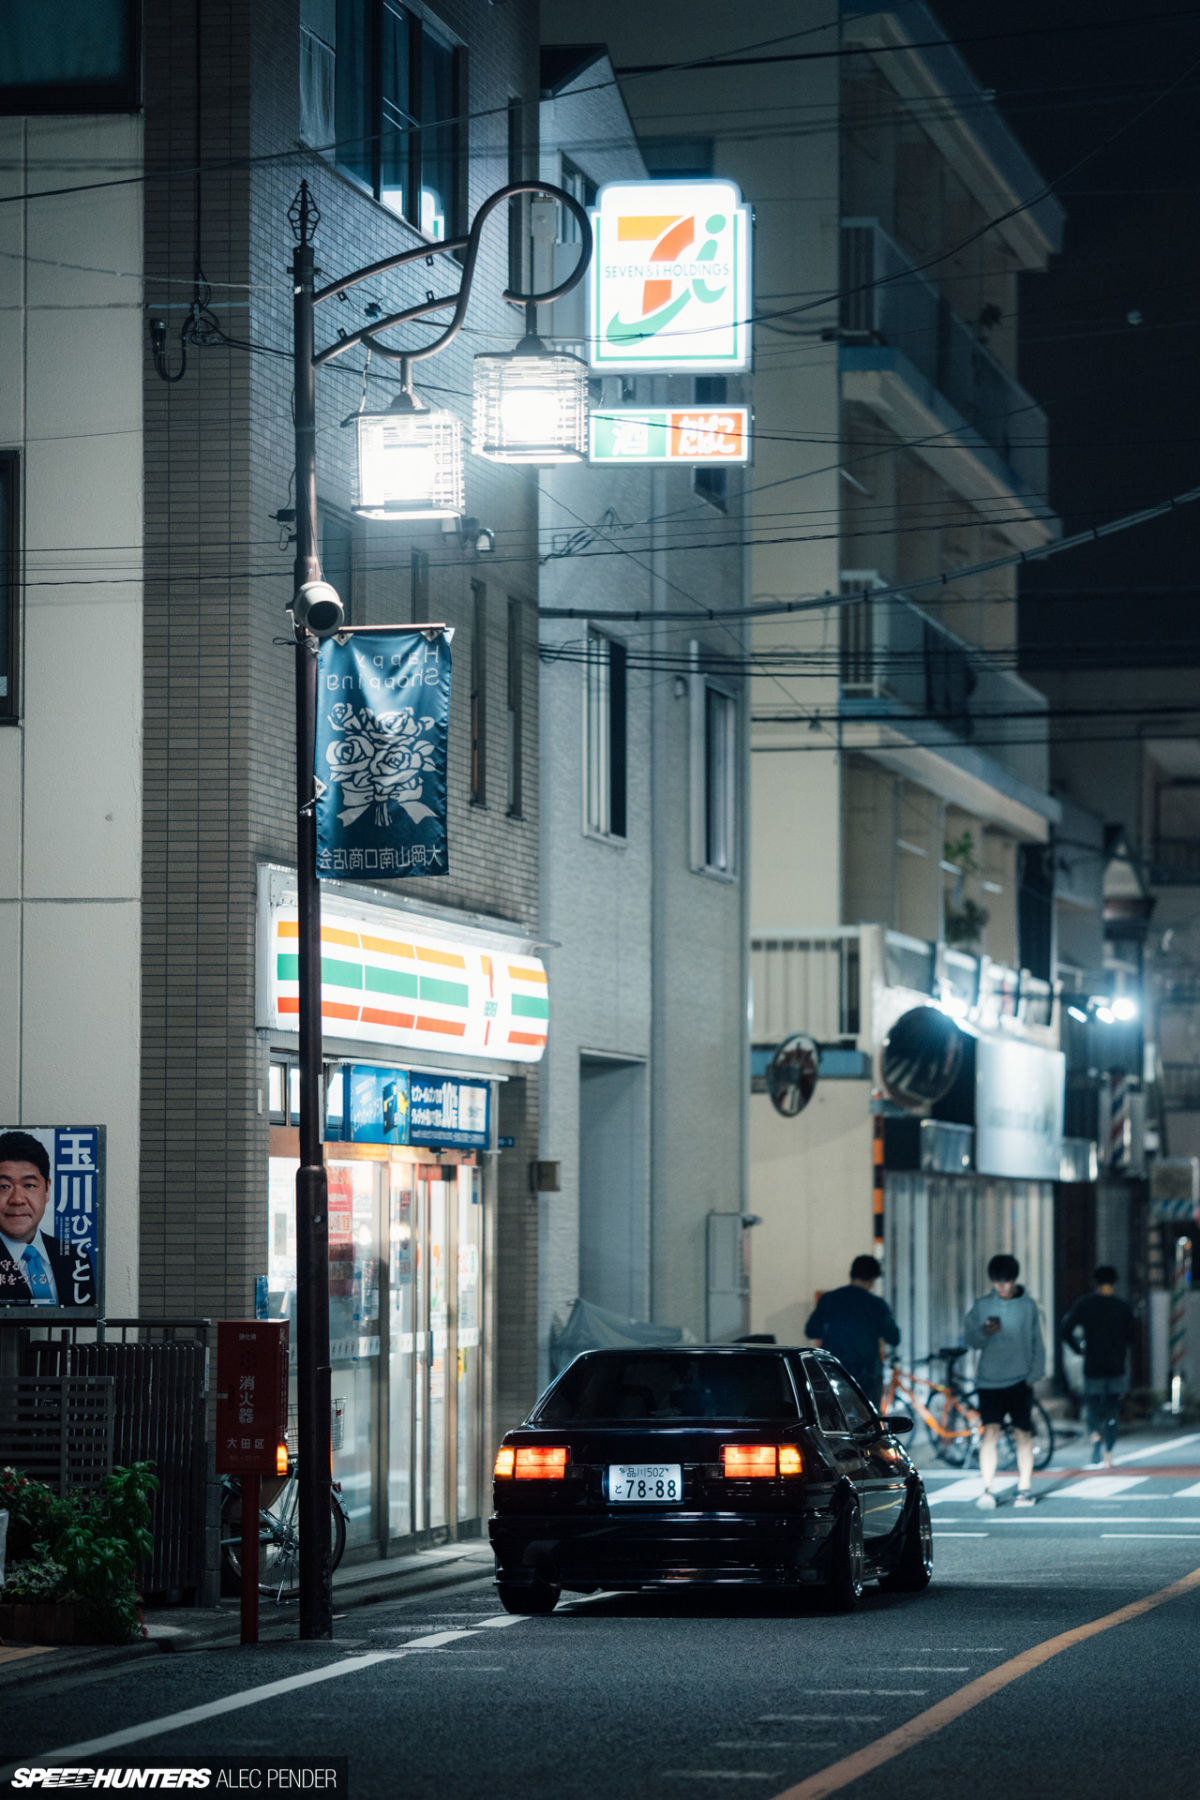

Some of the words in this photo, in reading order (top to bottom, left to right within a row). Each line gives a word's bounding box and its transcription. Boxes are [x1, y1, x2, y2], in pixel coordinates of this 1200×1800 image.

[663, 263, 729, 277] HOLDINGS
[612, 417, 649, 455] 酒
[678, 414, 736, 455] たばこ
[57, 1133, 95, 1305] 玉川ひでとし
[239, 1375, 255, 1424] 消火器
[227, 1437, 265, 1449] 大田区
[615, 1485, 622, 1494] と
[626, 1479, 677, 1499] 78-88
